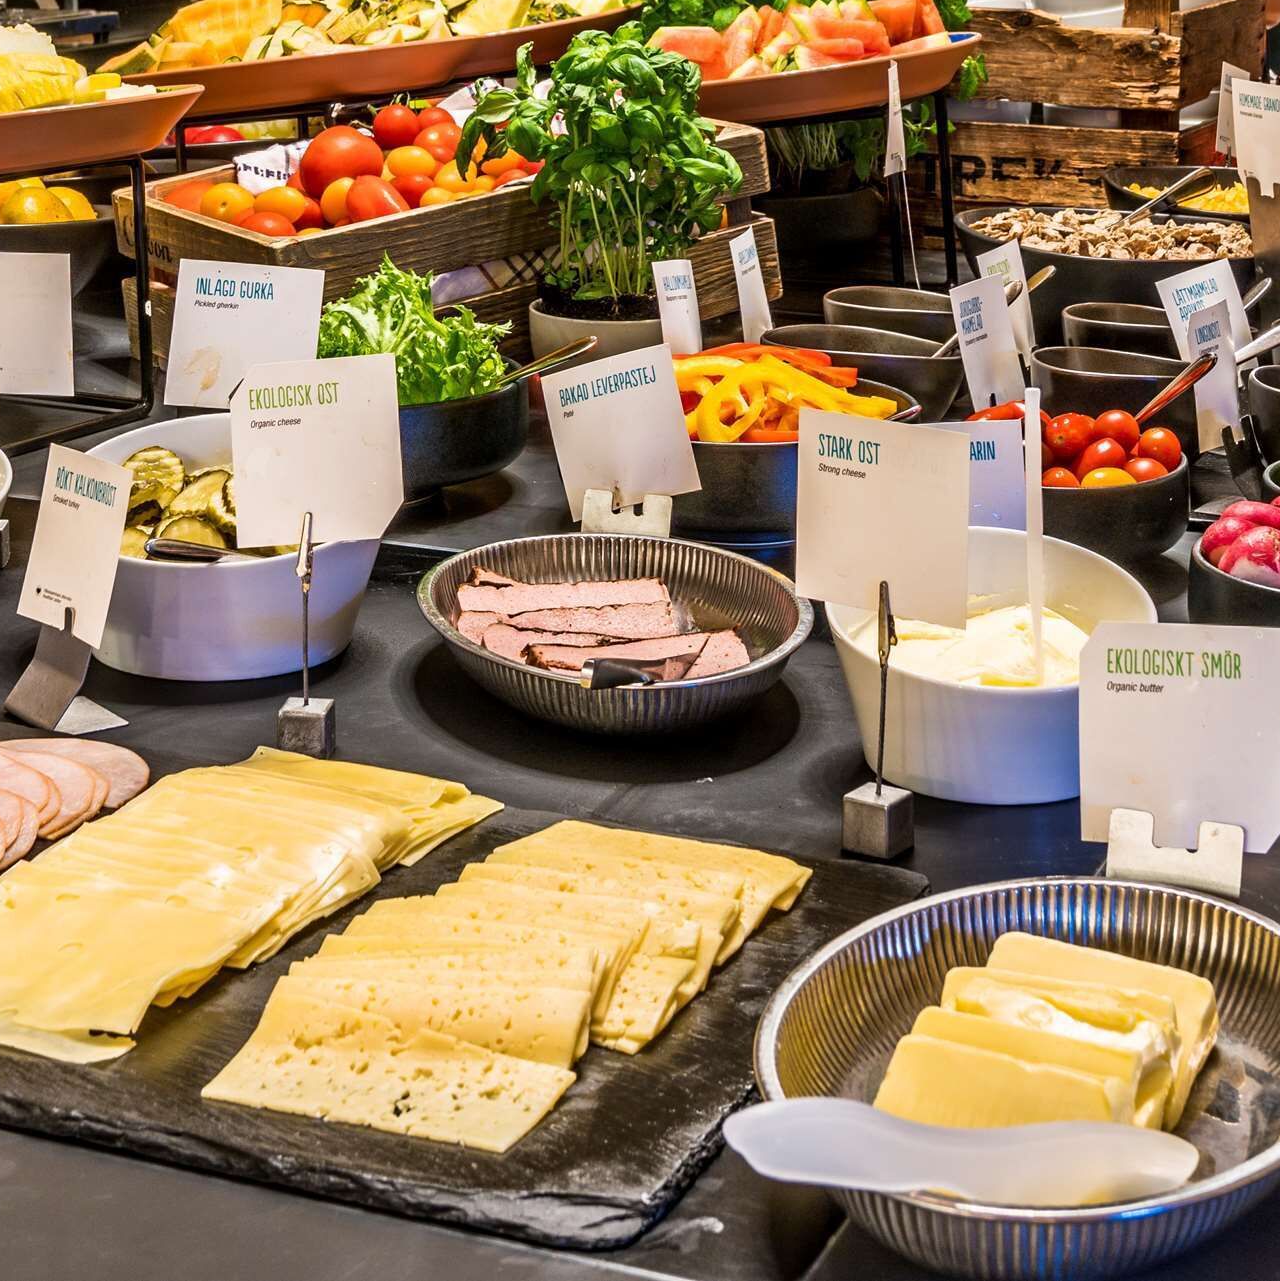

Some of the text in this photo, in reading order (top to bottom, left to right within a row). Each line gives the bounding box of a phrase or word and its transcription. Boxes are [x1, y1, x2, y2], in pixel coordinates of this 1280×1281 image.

[239, 280, 274, 300] GURKA
[194, 300, 240, 309] Pickled gherkin
[249, 382, 339, 410] EKOLOGISK OST
[559, 365, 656, 408] BAKAD LEVERPASTEJ
[250, 417, 302, 429] Organic cheese
[818, 433, 881, 466] STARK OST
[969, 440, 996, 461] ARIN
[817, 462, 867, 479] Strong cheese
[55, 466, 117, 508] RÖKT KALKONBRÖST
[52, 494, 69, 506] Smoked
[1107, 648, 1241, 680] EKOLOGISKT SMÖR
[1106, 681, 1164, 693] Organic butter
